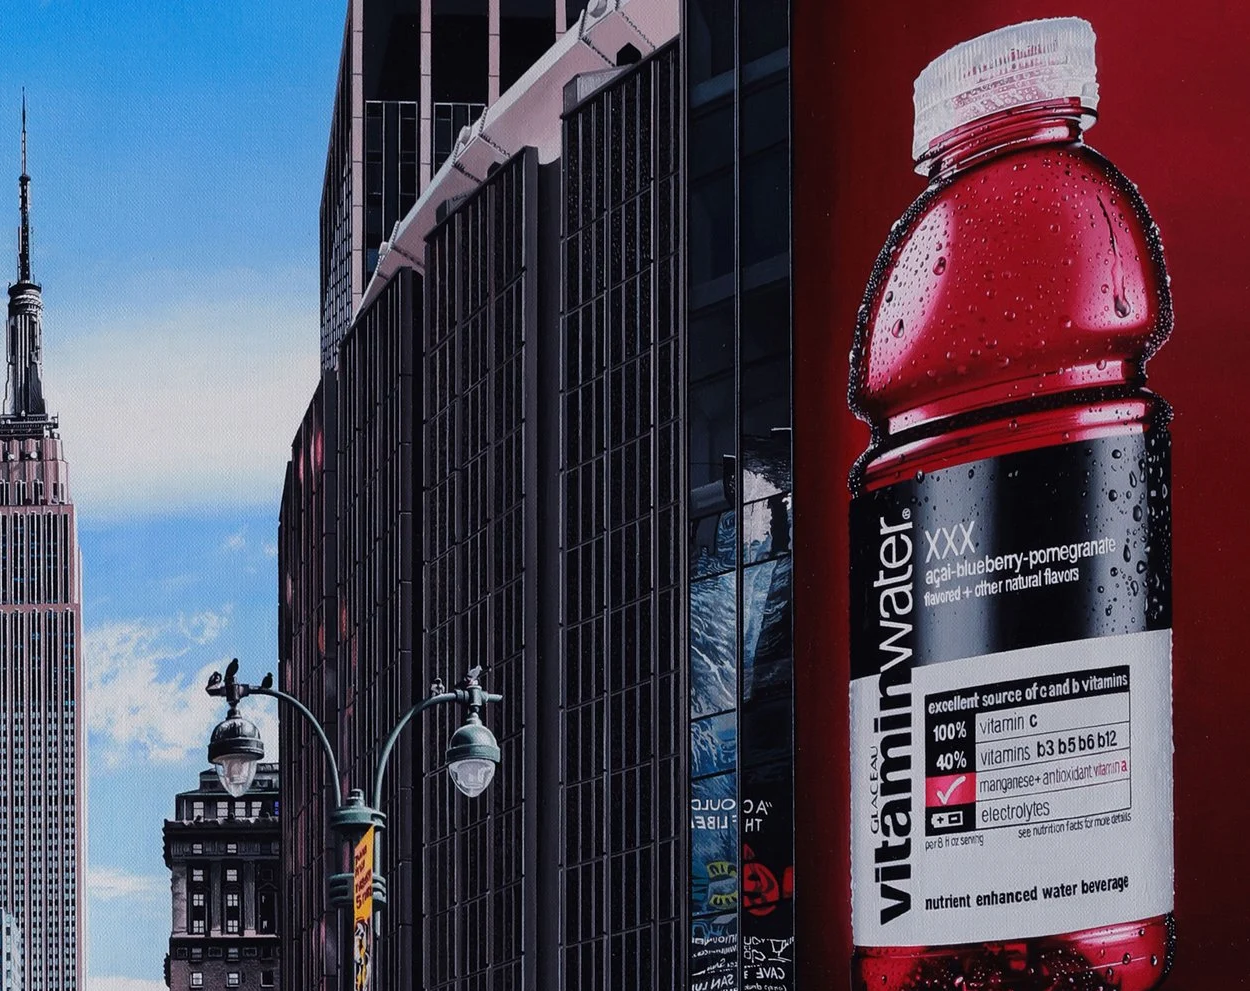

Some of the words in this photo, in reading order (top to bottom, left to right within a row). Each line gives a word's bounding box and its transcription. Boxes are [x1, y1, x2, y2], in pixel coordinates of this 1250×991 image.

[925, 521, 975, 563] XXX
[924, 586, 961, 607] flavored
[975, 579, 1003, 598] other
[1005, 573, 1042, 593] natural
[1044, 567, 1080, 585] flavors
[928, 692, 980, 715] excellent
[982, 688, 1022, 707] source
[1025, 682, 1039, 700] of
[1039, 685, 1047, 698] c
[1049, 679, 1071, 697] and
[1072, 676, 1080, 693] b
[1081, 673, 1128, 692] vitamins
[933, 721, 967, 742] 100%
[979, 713, 1024, 735] vitamin
[1029, 714, 1038, 728] c
[980, 746, 1031, 766] vitamins
[1037, 740, 1054, 757] b3
[1058, 737, 1076, 755] b5
[1078, 734, 1095, 751] b6
[1098, 730, 1118, 748] b12
[936, 750, 967, 771] 40%
[1043, 764, 1092, 785] antioxidant
[1093, 762, 1120, 776] vitamin
[981, 801, 1050, 823] electrolytes
[1018, 827, 1031, 839] see
[1033, 821, 1065, 836] nutrition
[925, 894, 971, 910] nutrient
[976, 886, 1038, 906] enhanced
[1042, 882, 1077, 899] water
[1081, 875, 1129, 894] beverage
